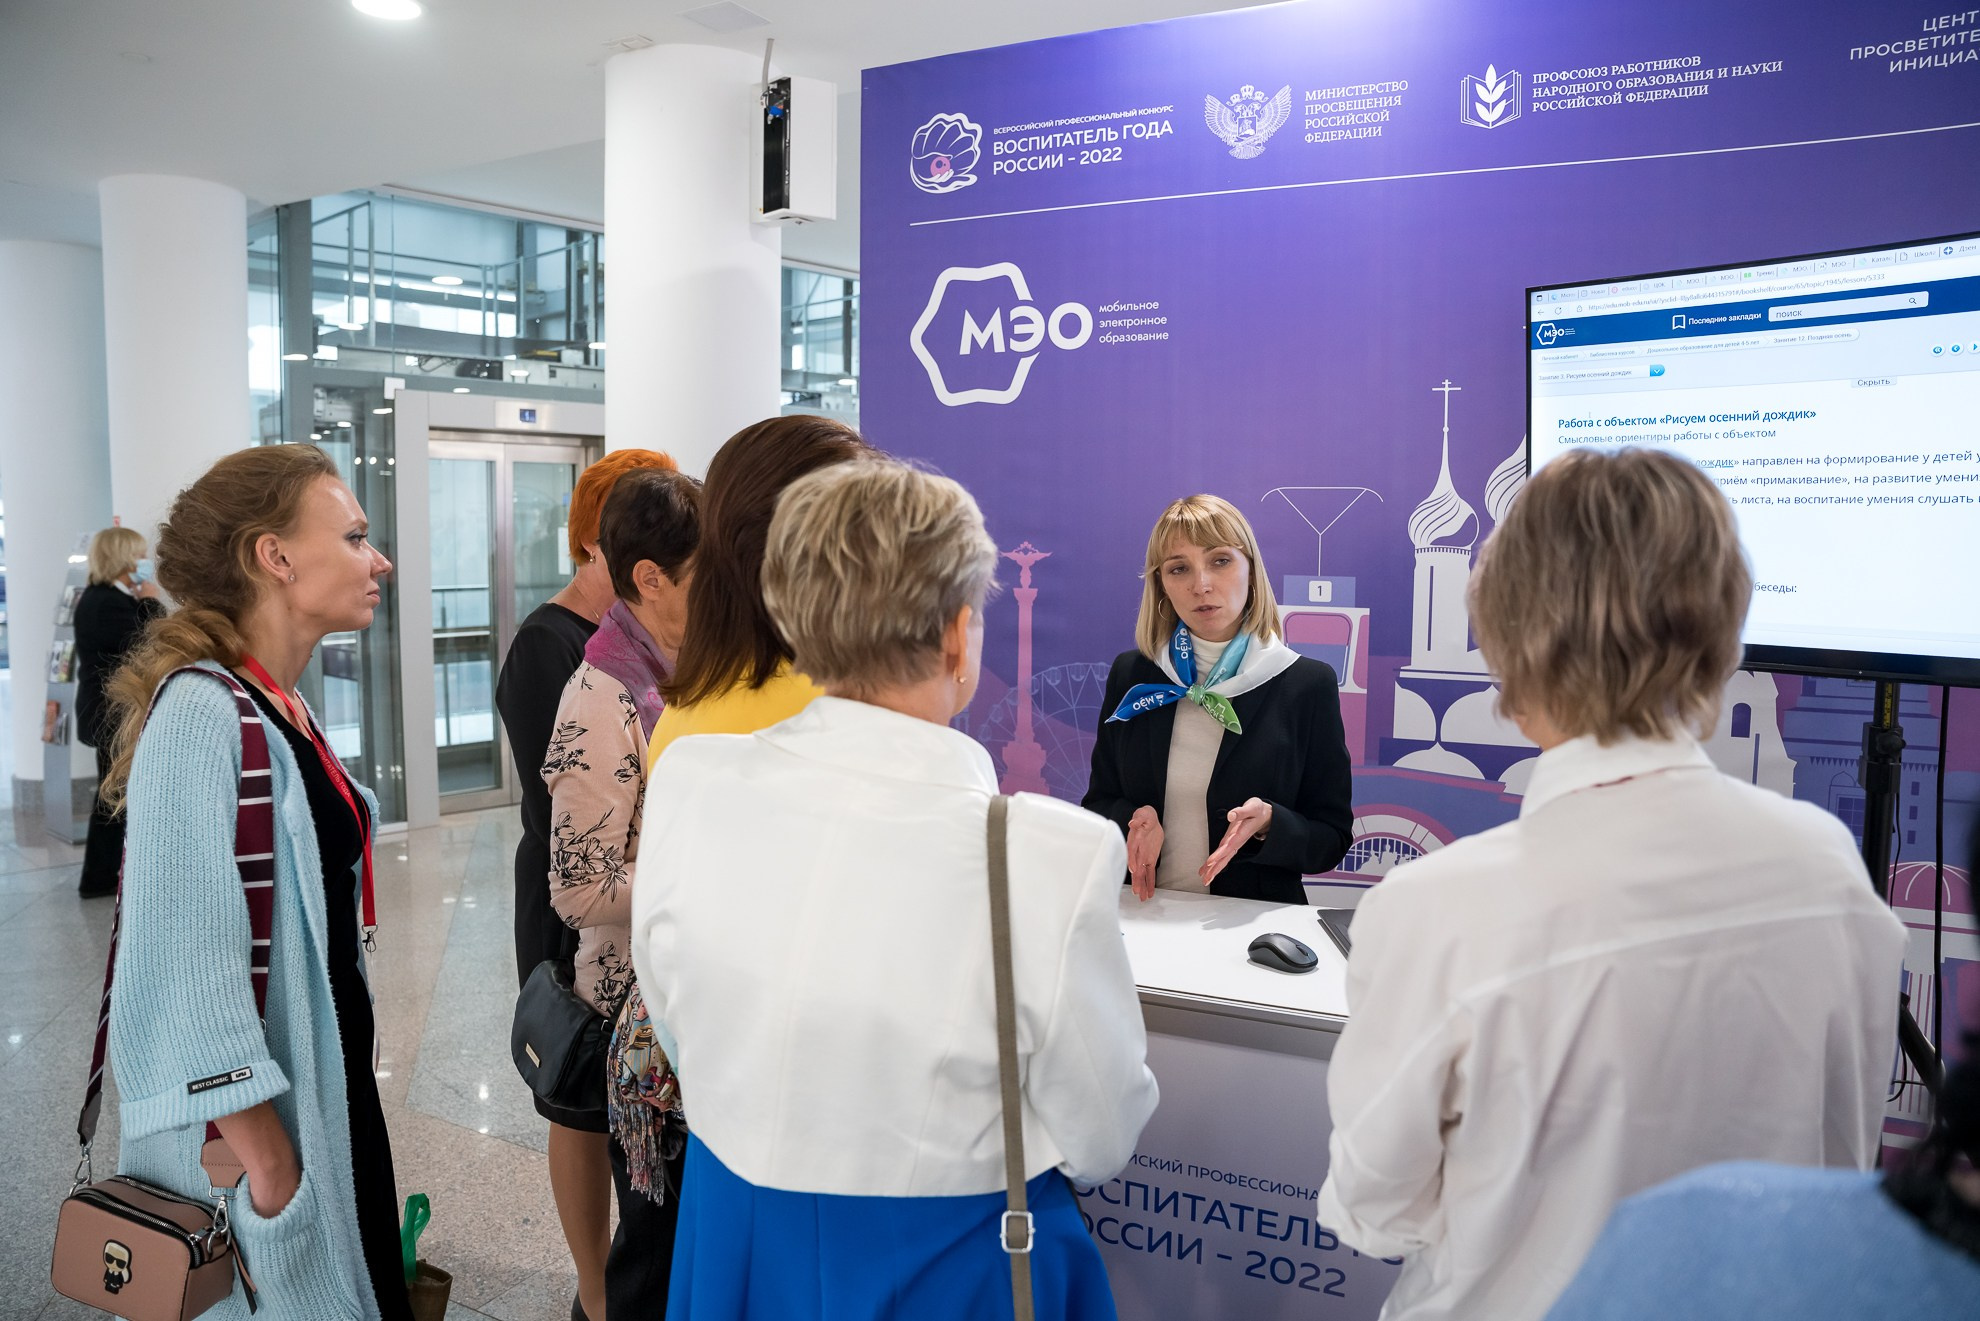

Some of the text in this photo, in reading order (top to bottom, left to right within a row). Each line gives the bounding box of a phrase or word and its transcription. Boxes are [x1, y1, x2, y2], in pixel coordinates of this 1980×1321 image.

[1923, 10, 1980, 32] ЦЕНТ
[1850, 29, 1980, 60] ПРОСВЕТИТЕ
[1889, 47, 1980, 73] ИНИЦИА
[1533, 55, 1701, 84] ПРОФСОЮЗ РАБОТНИКОВ
[1532, 60, 1783, 98] НАРОДНОГО ОБРАЗОВАНИЯ И НАУКИ
[1305, 79, 1408, 101] МИНИСТЕРСТВО
[1532, 84, 1709, 111] РОССИЙСКОЙ ФЕДЕРАЦИИ
[1305, 95, 1402, 116] ПРОСВЕЩЕНИЯ
[993, 104, 1174, 135] ВСЕРОССИЙСКИЙ ПРОФЕССИОНАЛЬНЫЙ КОНКУРС
[1304, 108, 1390, 129] РОССИЙСКОЙ
[993, 119, 1173, 156] ВОСПИТАТЕЛЬ ГОДА
[1304, 126, 1382, 144] ФЕДЕРАЦИИ
[993, 154, 1063, 176] РОССИИ
[1079, 147, 1123, 166] 2022
[1099, 300, 1159, 313] мобильное
[1776, 310, 1802, 319] поиск
[959, 302, 1094, 355] МЭО
[1099, 315, 1168, 329] электронное
[1688, 313, 1762, 327] Последние закладки
[1099, 330, 1169, 345] образование
[1544, 328, 1565, 338] МЭО
[1680, 342, 1713, 352] образование
[1724, 340, 1740, 349] детей
[1566, 372, 1586, 380] Рисуем
[1587, 370, 1609, 378] осенний
[1610, 369, 1632, 378] дождик
[1857, 378, 1890, 388] Скрыть
[1558, 418, 1594, 428] Работа
[1604, 415, 1657, 427] объектом
[1659, 413, 1706, 426] «Рисуем
[1708, 410, 1760, 423] осенний
[1762, 409, 1817, 424] дождик»
[1558, 435, 1613, 444] Смысловые
[1615, 432, 1671, 444] ориентиры
[1673, 430, 1712, 442] работы
[1722, 428, 1776, 440] объектом
[1742, 455, 1803, 468] направлен
[1807, 456, 1821, 465] на
[1824, 452, 1919, 466] формирование
[1922, 454, 1930, 464] у
[1932, 450, 1972, 464] детей
[1713, 473, 1980, 487] приём «примакивание», на развитие умени
[1740, 495, 1774, 506] листа,
[1777, 495, 1791, 505] на
[1794, 495, 1864, 505] воспитание
[1866, 495, 1914, 506] умения
[1917, 495, 1974, 506] слушать
[1754, 581, 1798, 594] беседы:
[205, 1076, 229, 1087] CLASSIC
[1245, 1250, 1347, 1298] 2022
